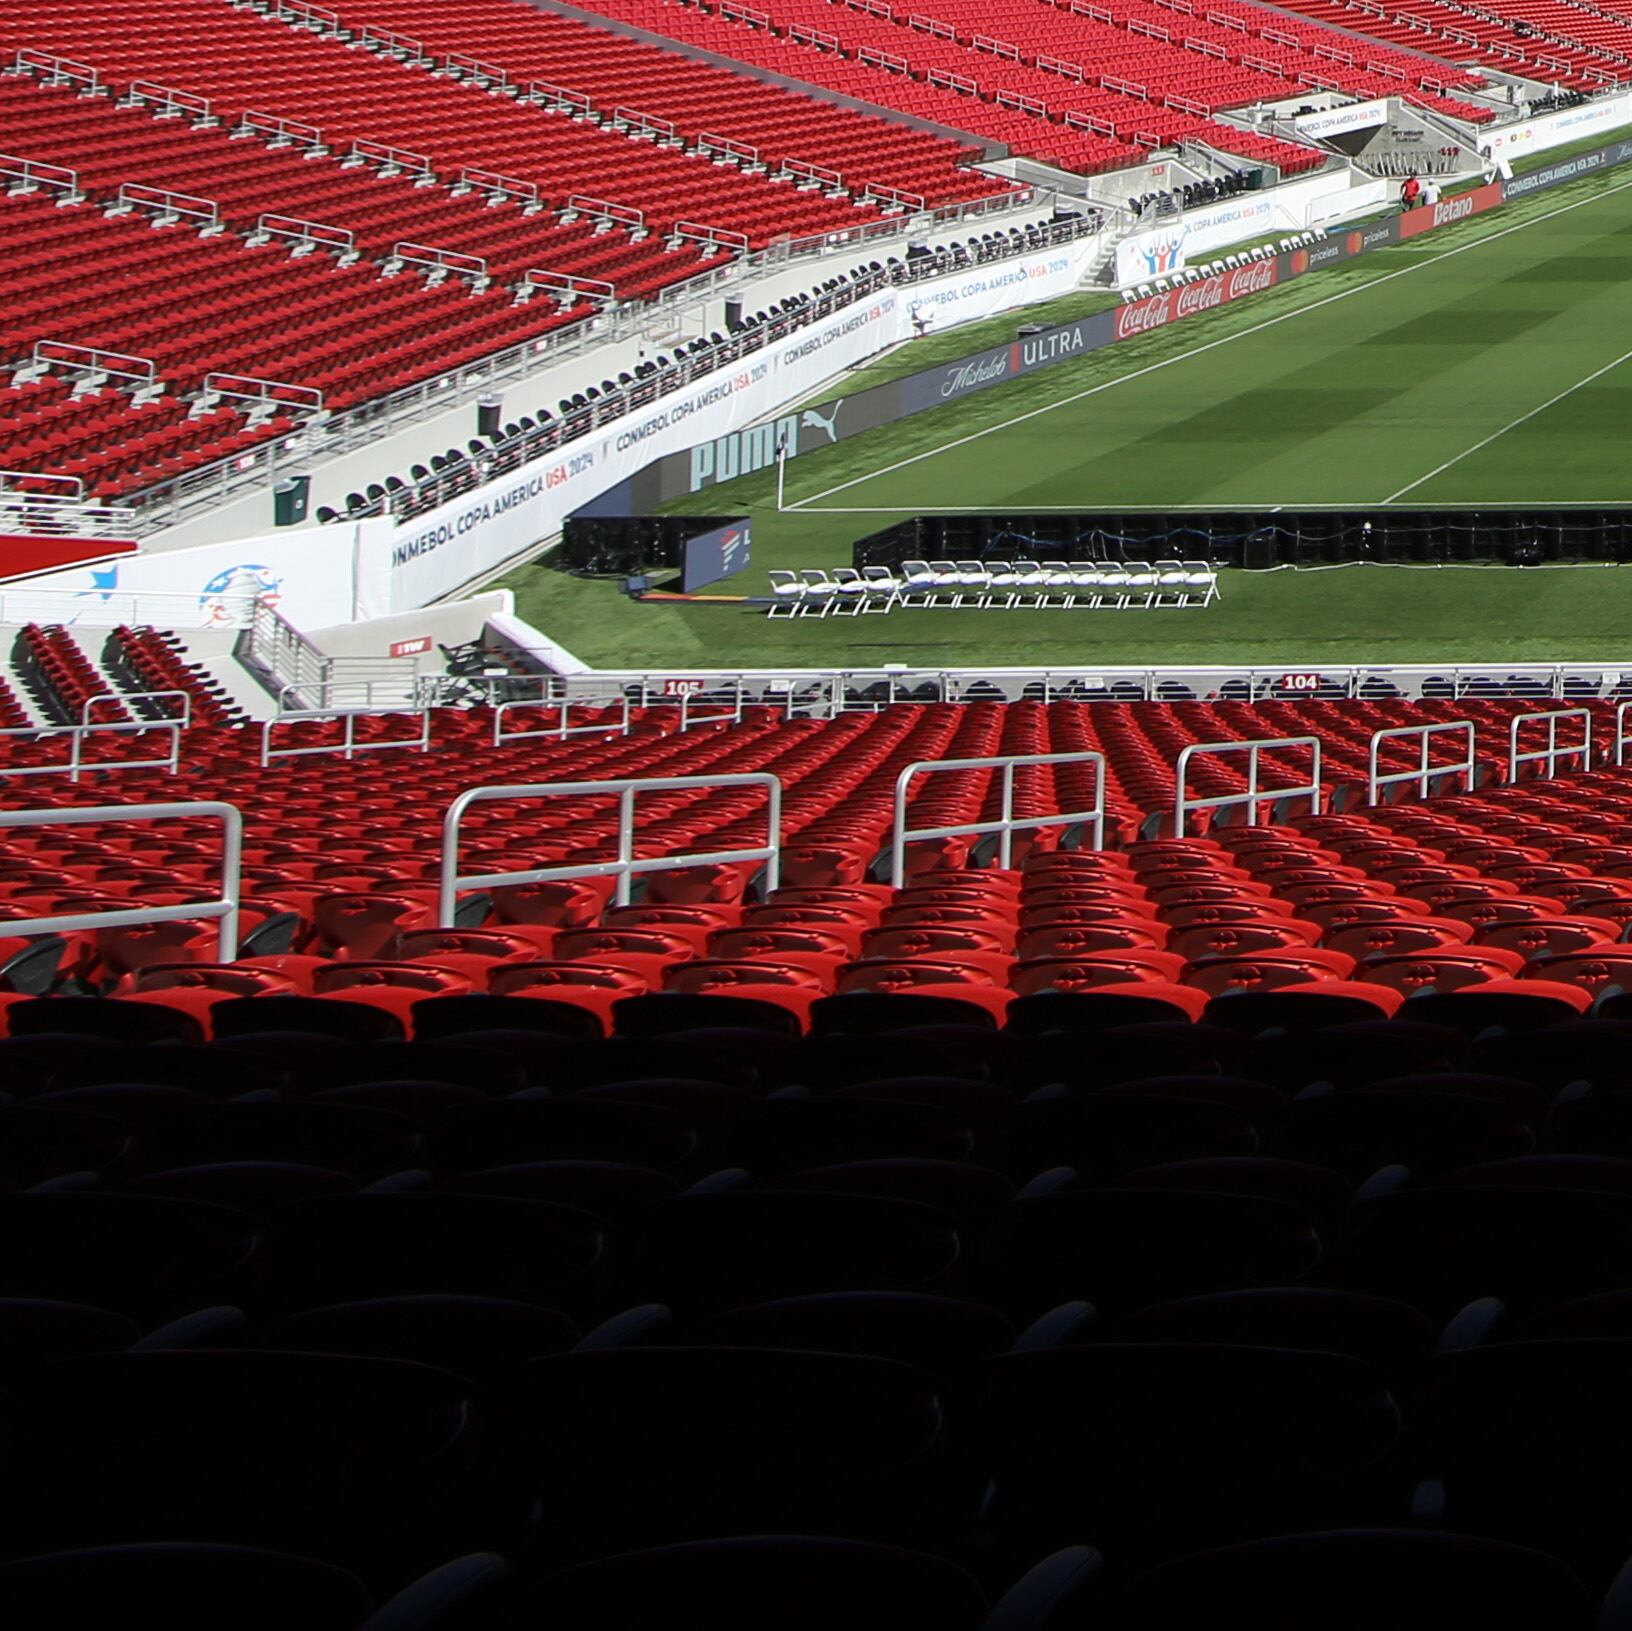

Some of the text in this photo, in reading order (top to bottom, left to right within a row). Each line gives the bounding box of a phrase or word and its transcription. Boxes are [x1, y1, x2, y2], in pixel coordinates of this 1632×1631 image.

[1363, 228, 1390, 248] priceless
[1310, 245, 1339, 266] priceless
[941, 327, 1084, 397] Michelob ULTRA
[616, 364, 768, 452] CONMEBOL COPA AMERICA USA 2024
[456, 503, 491, 535] COPA
[491, 476, 544, 514] AMERICA
[545, 465, 568, 489] USA
[569, 451, 594, 478] 2024
[665, 680, 700, 696] 105
[1284, 674, 1318, 690] 104
